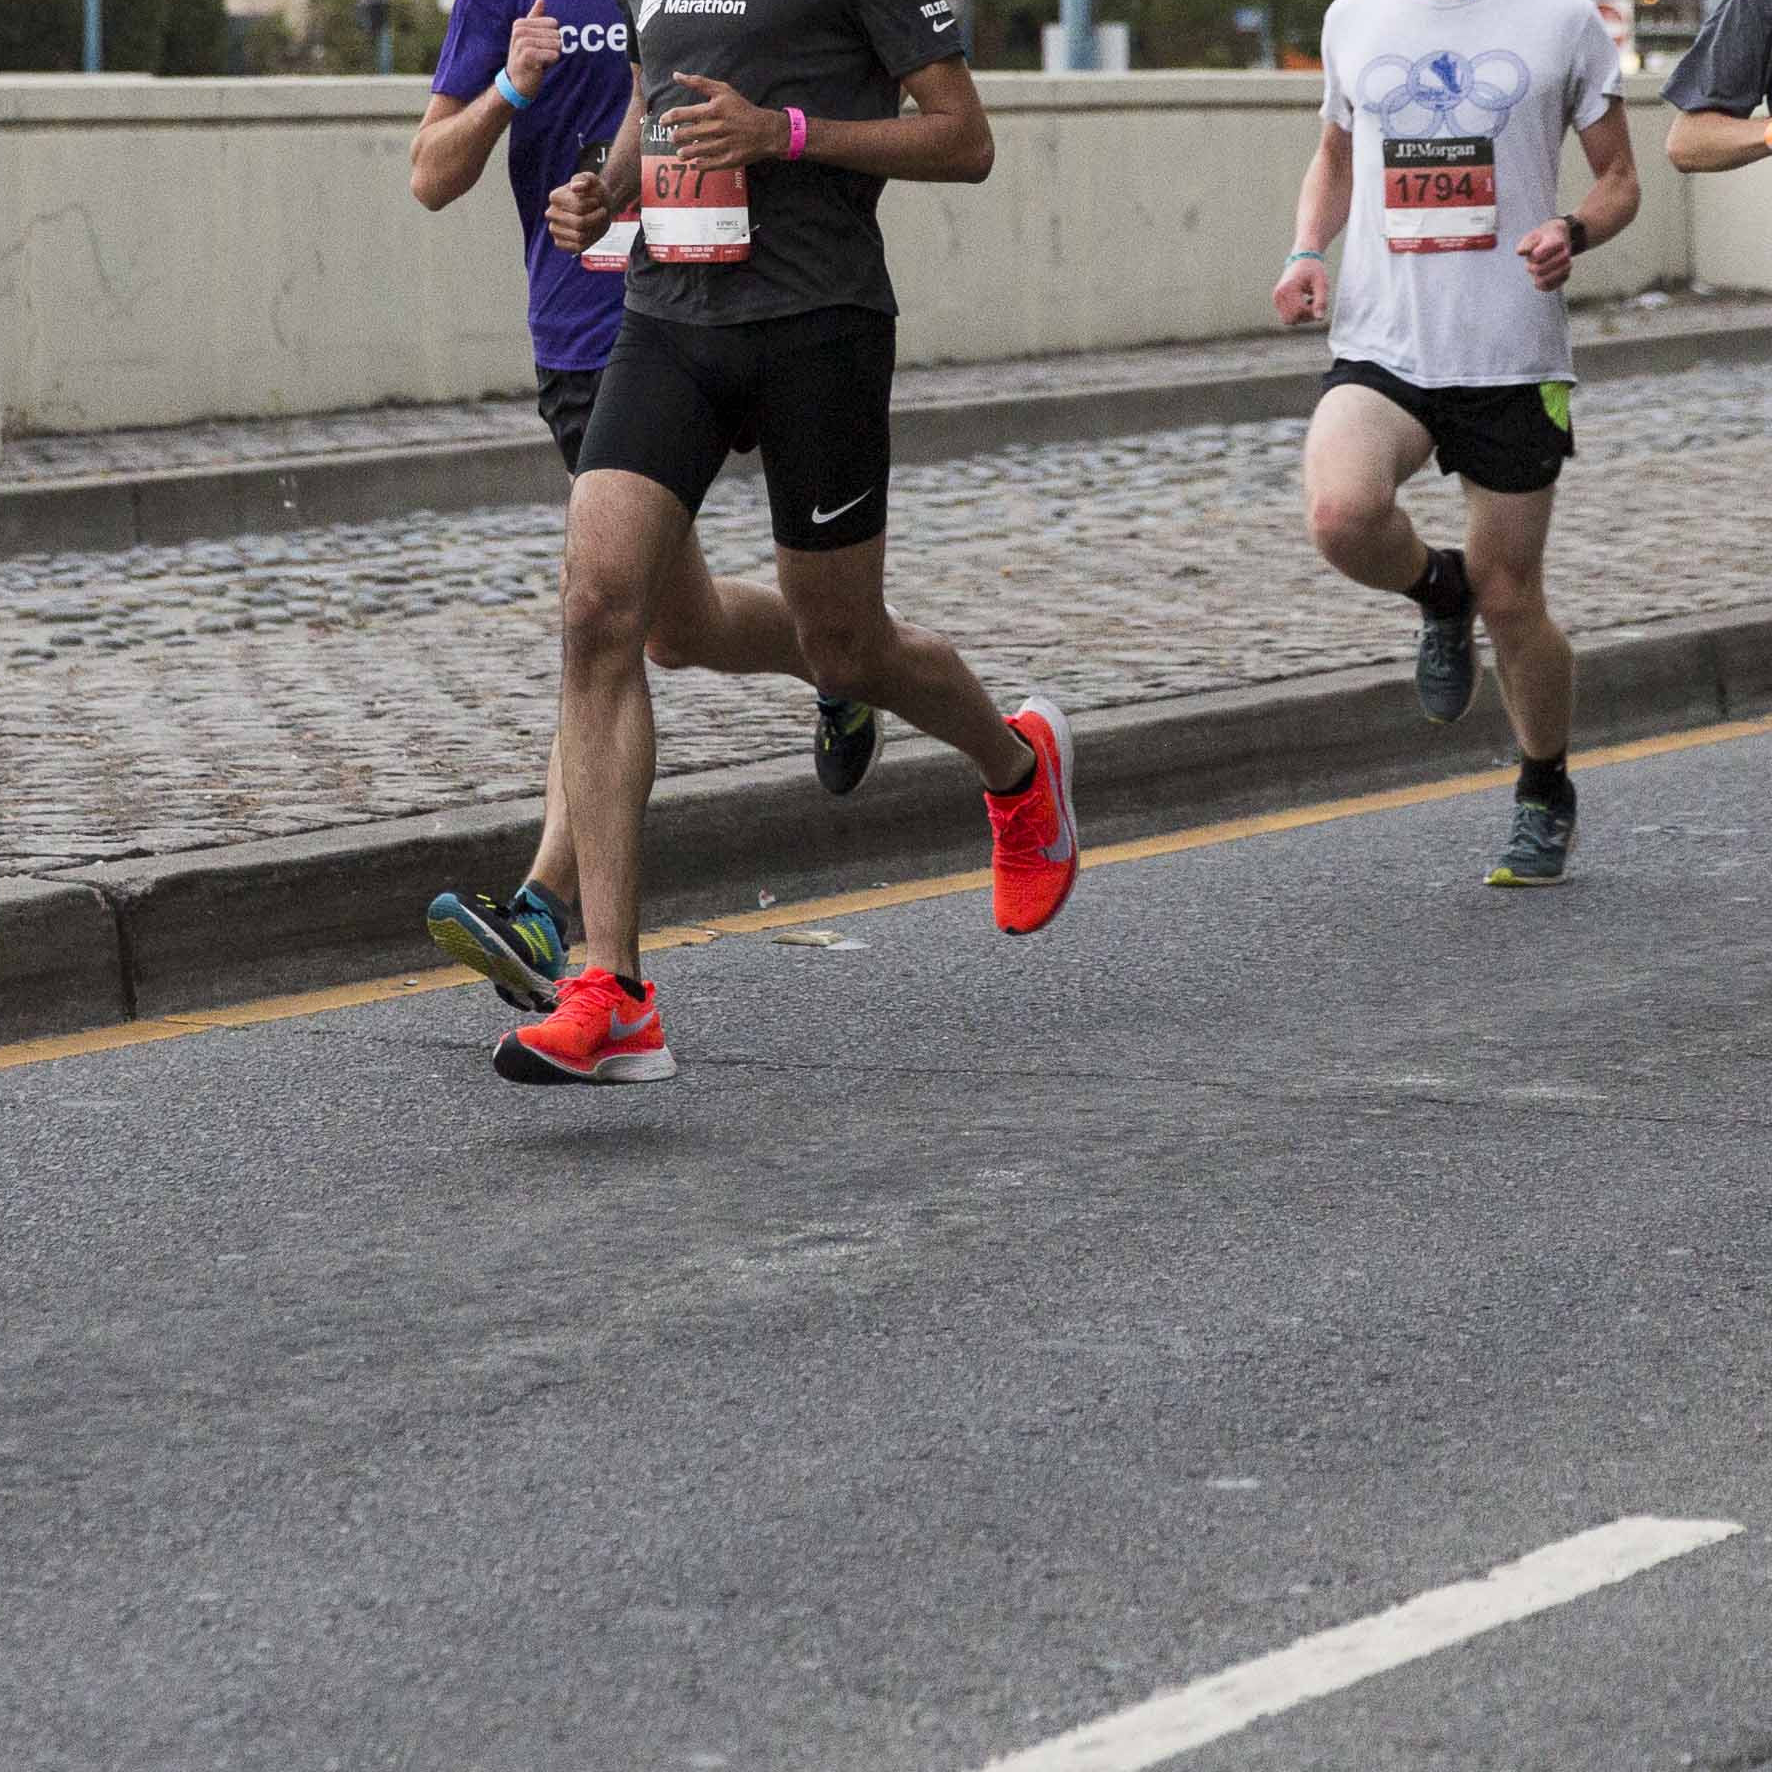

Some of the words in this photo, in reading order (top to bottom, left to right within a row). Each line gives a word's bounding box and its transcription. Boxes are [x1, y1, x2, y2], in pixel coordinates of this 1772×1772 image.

[1394, 142, 1476, 162] J.P.Morgan
[655, 163, 707, 199] 677
[1395, 172, 1475, 203] 1794
